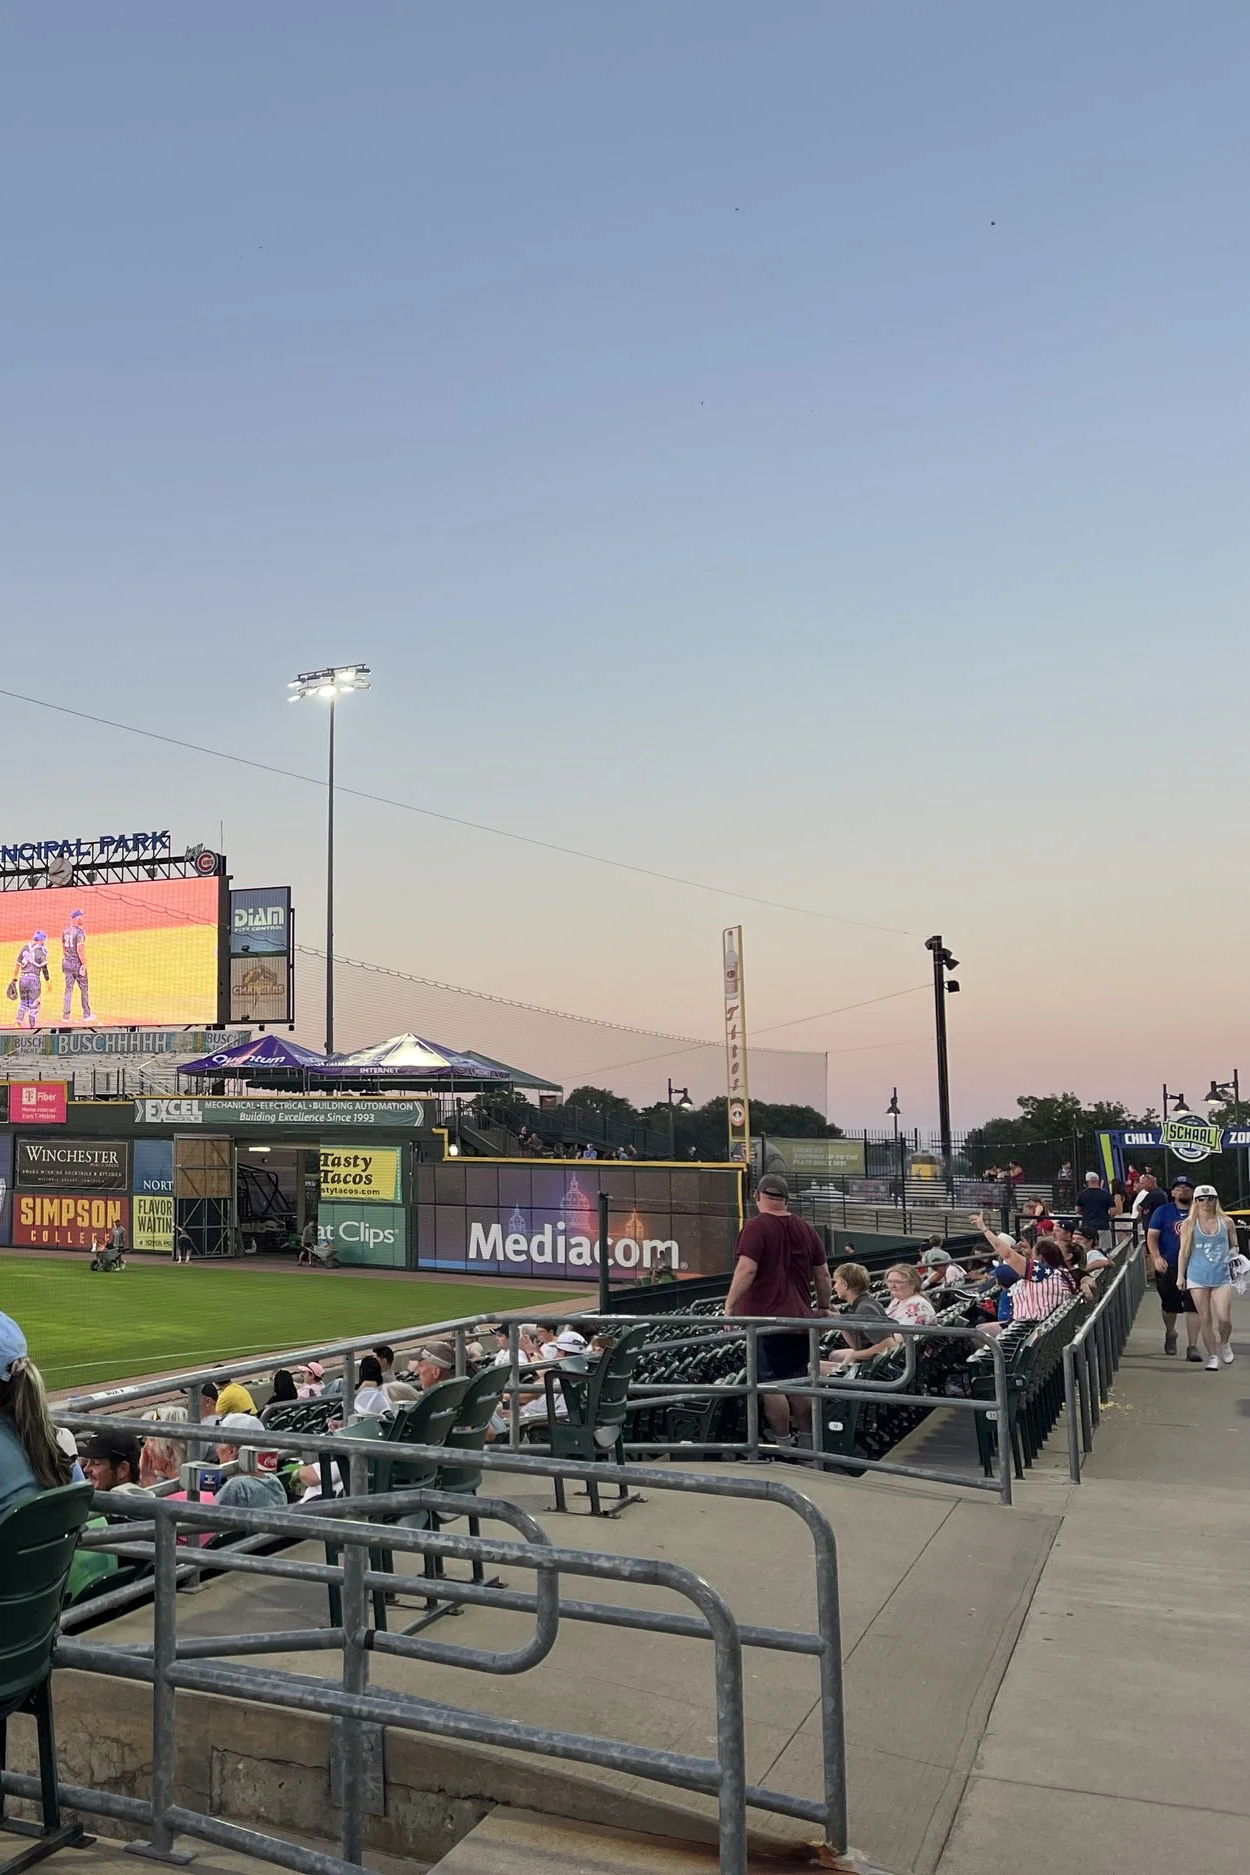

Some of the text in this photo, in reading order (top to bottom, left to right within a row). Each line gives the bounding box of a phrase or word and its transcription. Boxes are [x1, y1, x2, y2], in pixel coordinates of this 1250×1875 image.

[99, 830, 170, 855] PARK
[14, 1037, 45, 1048] BUSCH
[38, 1092, 56, 1101] Fiber
[146, 1100, 202, 1122] EXCEL
[204, 1101, 414, 1111] MECHANICAL ELECTRICAL BUILDING AUTOMATION
[239, 1112, 375, 1123] Building Excellence Since 1993
[1124, 1133, 1156, 1144] CHILL
[1170, 1124, 1213, 1144] SCHAAL
[26, 1146, 118, 1164] WINCHESTER
[320, 1153, 372, 1172] Tasty
[320, 1170, 373, 1185] Tacos
[20, 1198, 121, 1229] SIMPSON
[138, 1199, 172, 1215] FLAVOR
[339, 1221, 394, 1248] Clips
